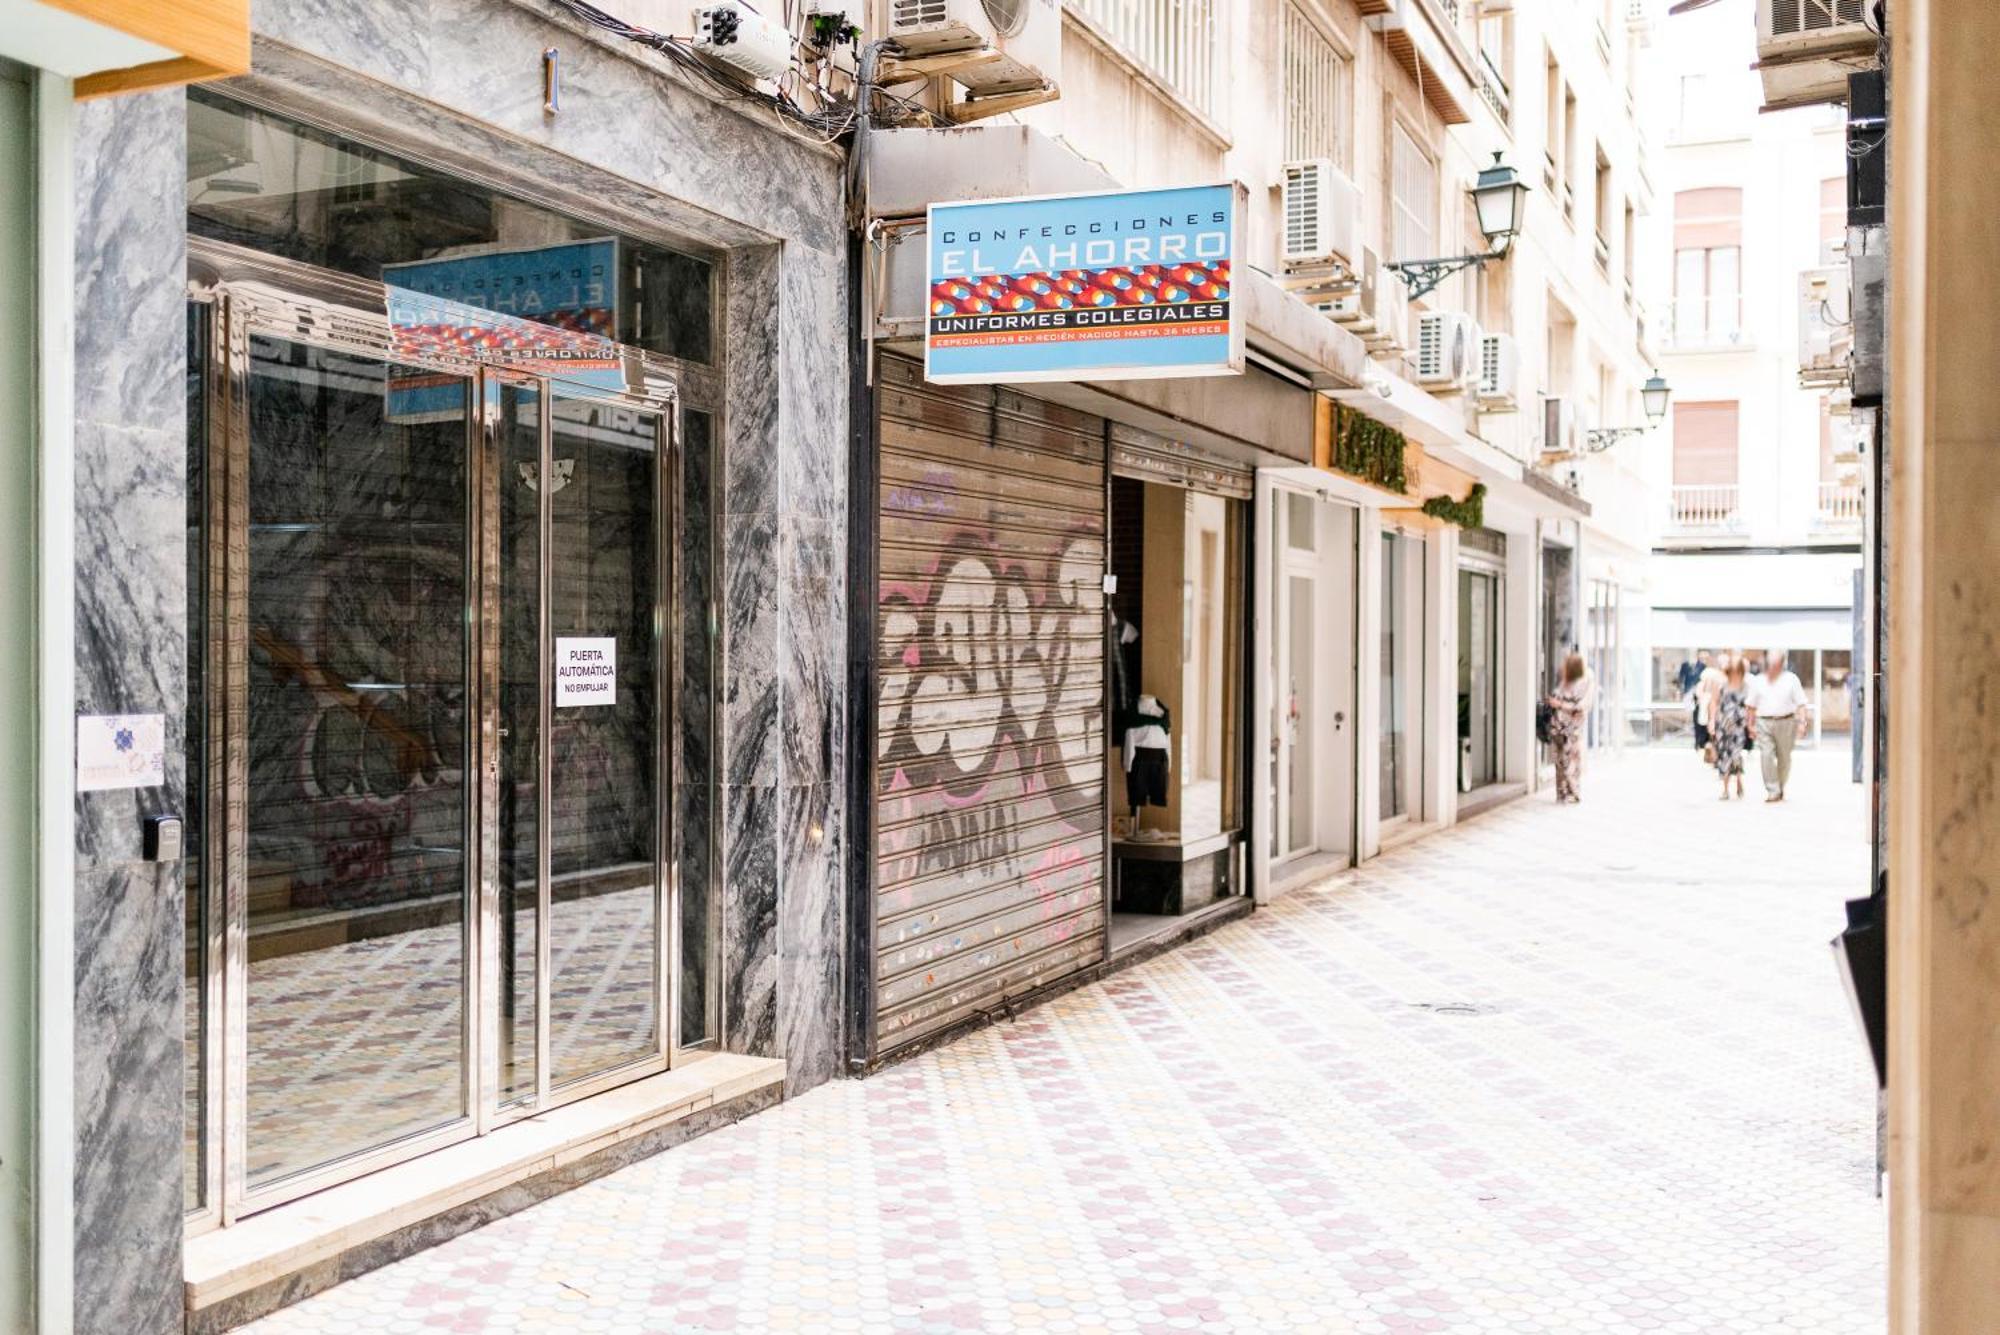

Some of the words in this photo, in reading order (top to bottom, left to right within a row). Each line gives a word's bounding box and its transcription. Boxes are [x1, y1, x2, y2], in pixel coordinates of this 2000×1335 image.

[943, 211, 1226, 244] CONFECCIONES
[942, 248, 996, 275] EL
[1012, 230, 1227, 271] AHORRO
[937, 312, 1067, 332] UNIFORMES
[1075, 304, 1224, 325] COLEGIALES
[935, 335, 1015, 347] ESPECIALISTAS
[1017, 334, 1033, 343] EN
[1035, 331, 1076, 342] RECIÉN
[1078, 330, 1121, 340] NACIDO
[1124, 327, 1161, 337] HASTA
[1163, 326, 1179, 336] 36
[1182, 324, 1222, 335] MESES
[570, 650, 603, 661] PUERTA
[559, 663, 614, 677] AUTOMÁTICA
[564, 683, 575, 693] NO
[576, 683, 608, 693] EMPUJAR
